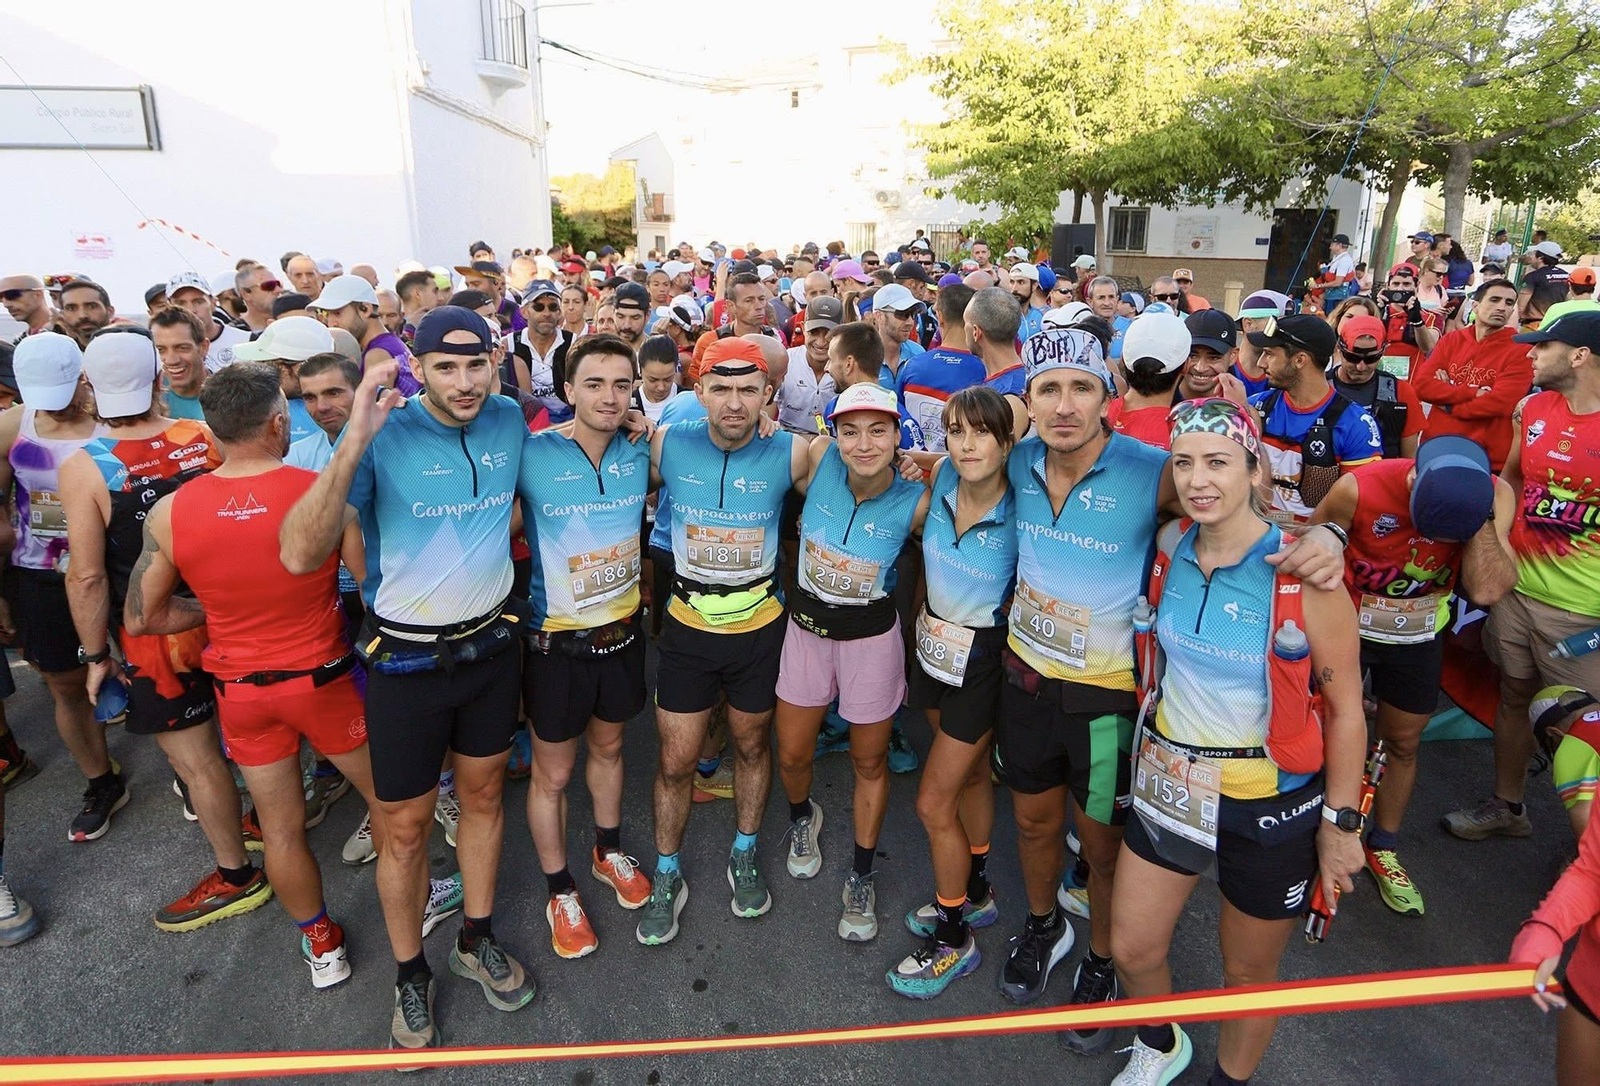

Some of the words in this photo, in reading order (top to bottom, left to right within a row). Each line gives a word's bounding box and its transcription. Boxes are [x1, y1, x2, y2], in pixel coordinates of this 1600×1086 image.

[698, 527, 707, 537] 13
[704, 545, 741, 563] 181
[590, 561, 627, 587] 186
[815, 566, 852, 591] 213
[1376, 598, 1386, 607] 13
[1029, 614, 1056, 638] 40
[1393, 615, 1408, 629] 9
[919, 631, 947, 660] 208
[1150, 773, 1190, 812] 152
[932, 951, 960, 977] HOKA
